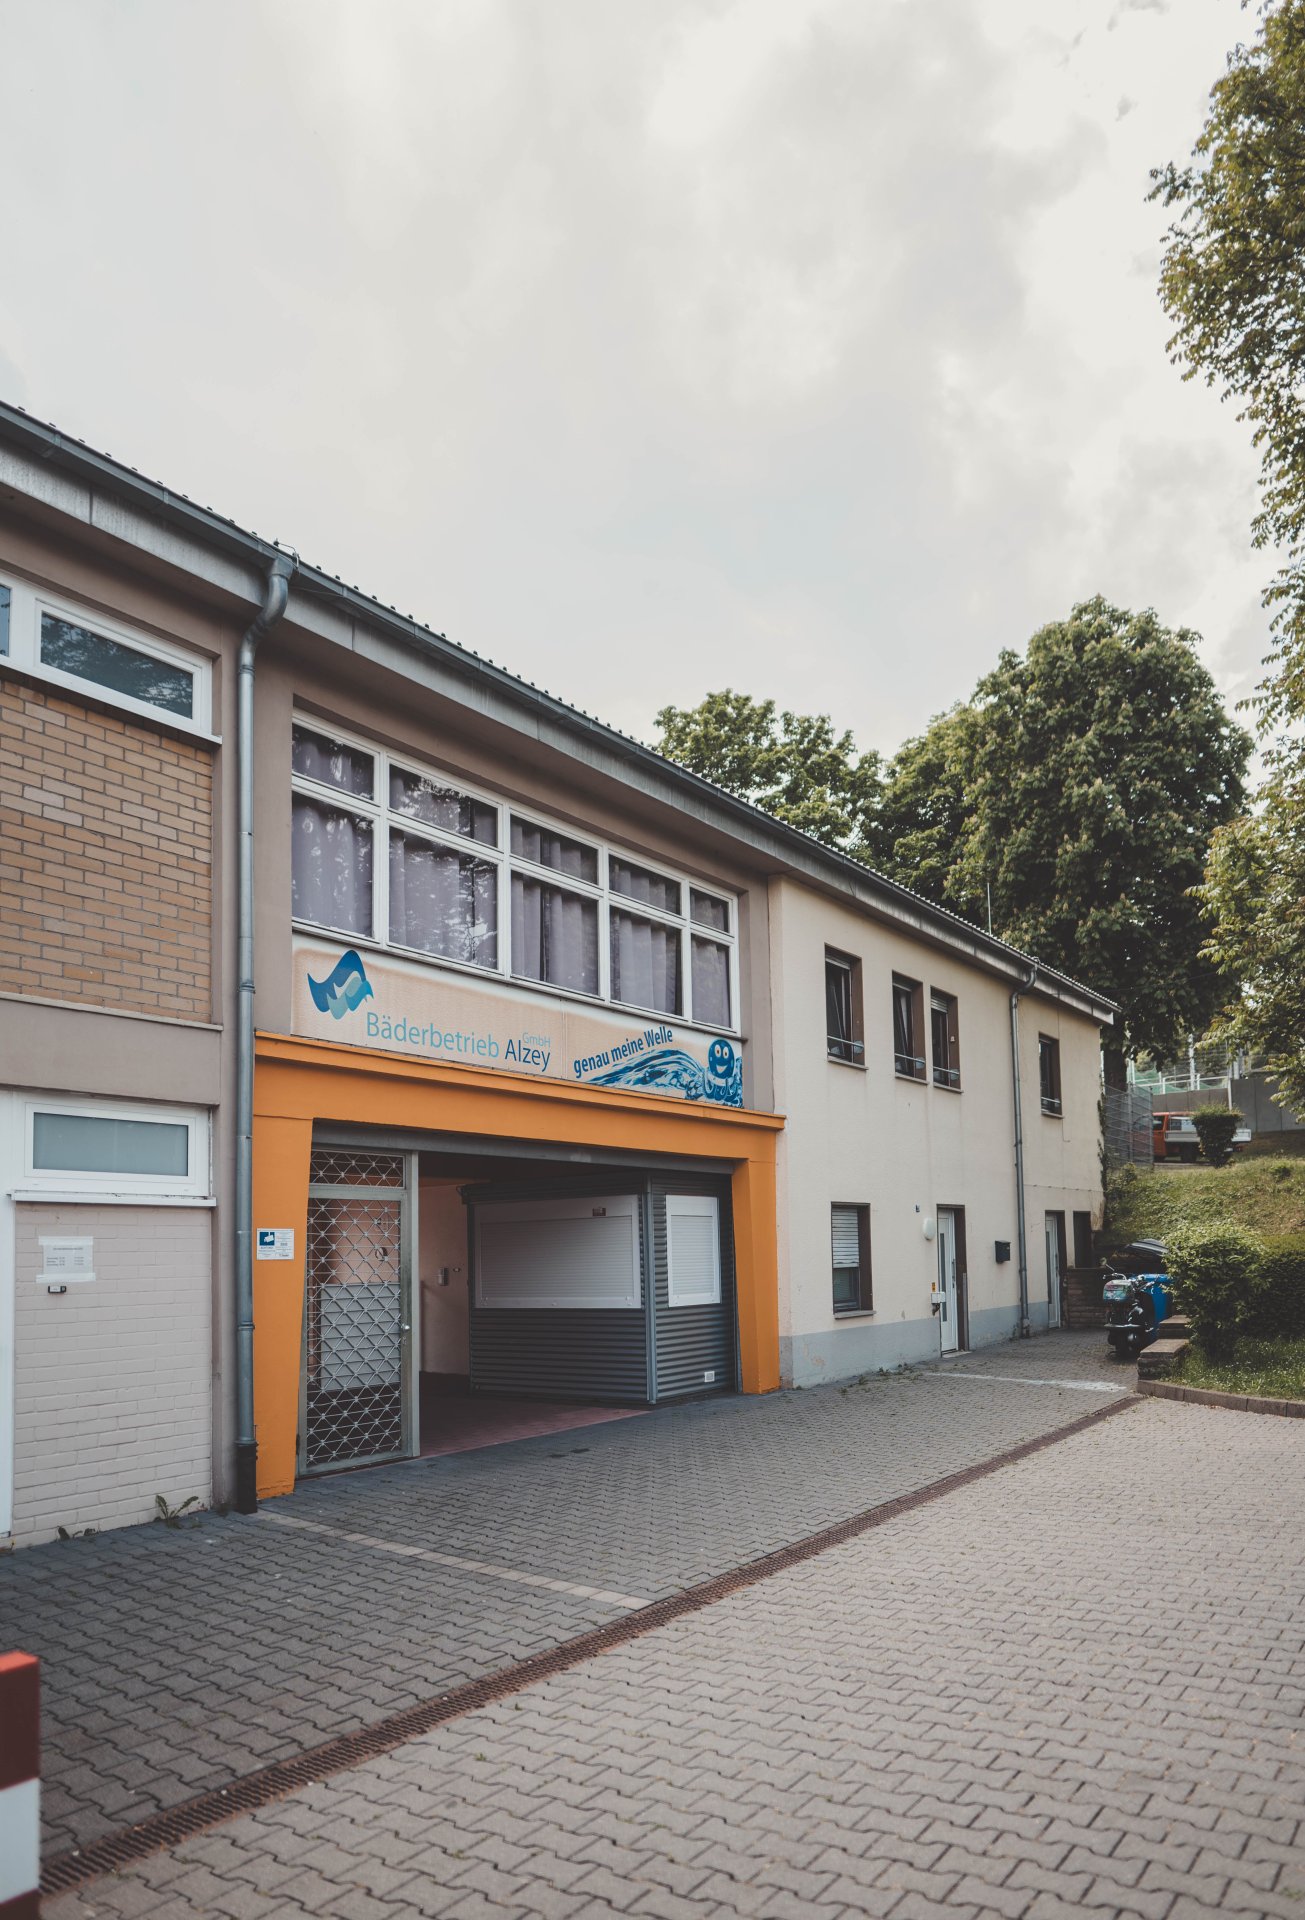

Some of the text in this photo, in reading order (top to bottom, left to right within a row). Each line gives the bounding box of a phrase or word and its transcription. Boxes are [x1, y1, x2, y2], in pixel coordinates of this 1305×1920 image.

[366, 1011, 551, 1072] Bäderbetrieb Alzey
[522, 1032, 551, 1048] GmbH
[573, 1025, 673, 1078] genau meine Welle
